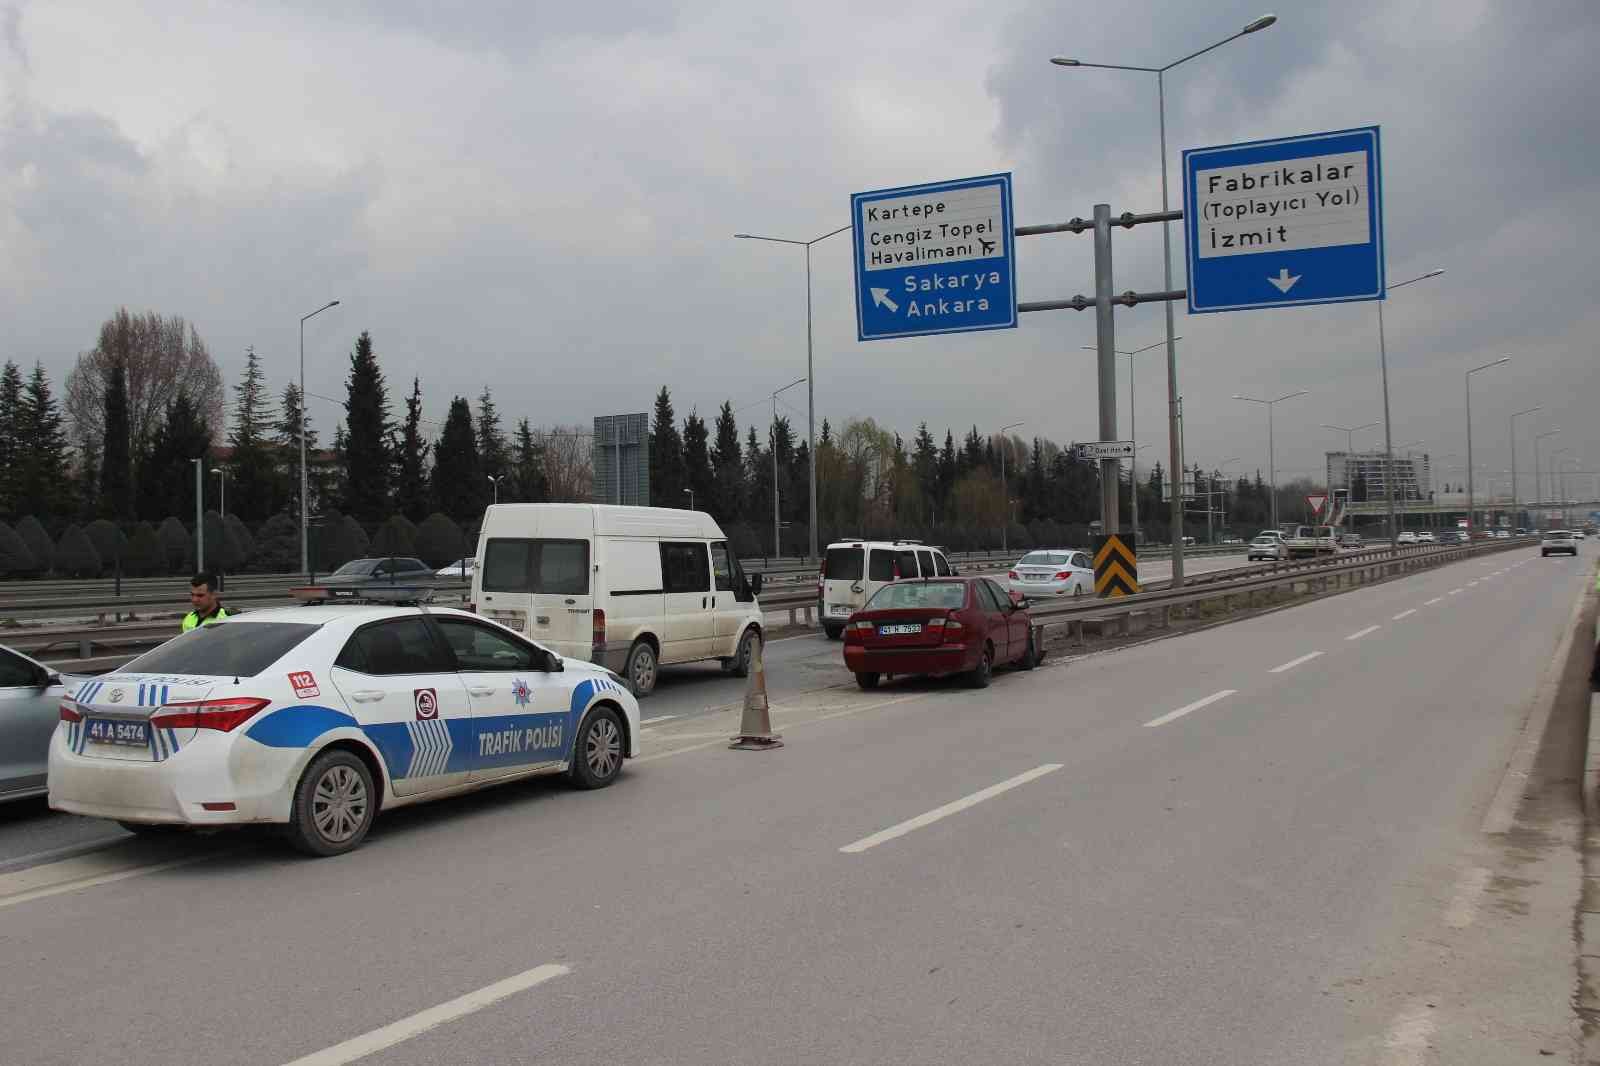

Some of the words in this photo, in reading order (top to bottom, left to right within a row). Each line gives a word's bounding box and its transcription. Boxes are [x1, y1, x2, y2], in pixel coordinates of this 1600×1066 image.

[1208, 164, 1354, 194] Fabrikalar
[868, 202, 946, 222] Kartepe
[1203, 197, 1307, 221] (Toplayıcı
[1316, 185, 1359, 208] Yol)
[870, 227, 932, 246] Cengiz
[938, 218, 993, 239] Topel
[1210, 225, 1288, 249] İzmit
[871, 244, 972, 265] Havalimanı
[904, 271, 1000, 292] Sakarya
[907, 297, 990, 318] Ankara
[293, 674, 314, 688] 112
[91, 722, 103, 737] 41
[107, 723, 114, 738] A
[117, 724, 145, 740] 5474
[479, 723, 522, 757] TRAFİK
[524, 719, 563, 752] POLİSİ
